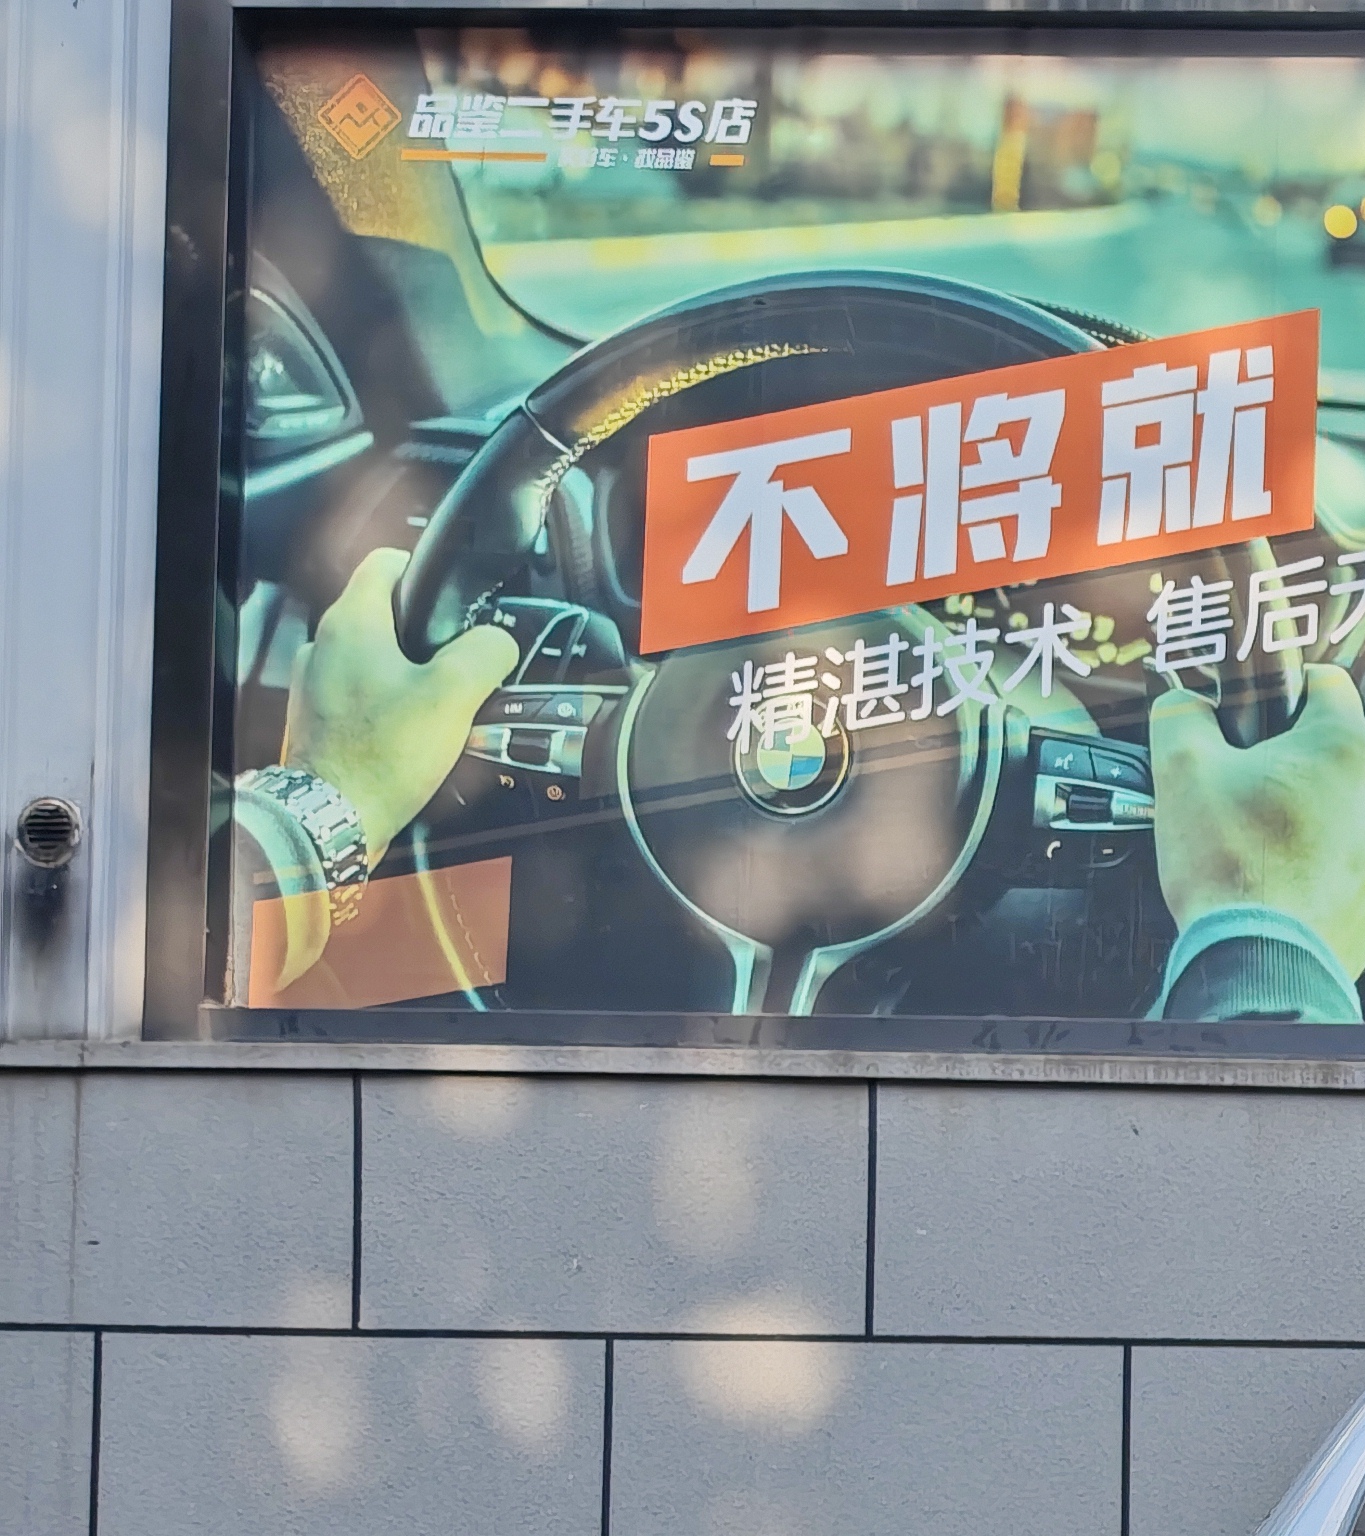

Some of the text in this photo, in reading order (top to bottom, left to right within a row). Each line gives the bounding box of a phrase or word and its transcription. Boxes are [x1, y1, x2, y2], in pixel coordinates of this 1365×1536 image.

[407, 93, 759, 145] 品鉴二手车5S店
[681, 345, 1275, 614] 不将就
[726, 602, 1094, 754] 精湛技术
